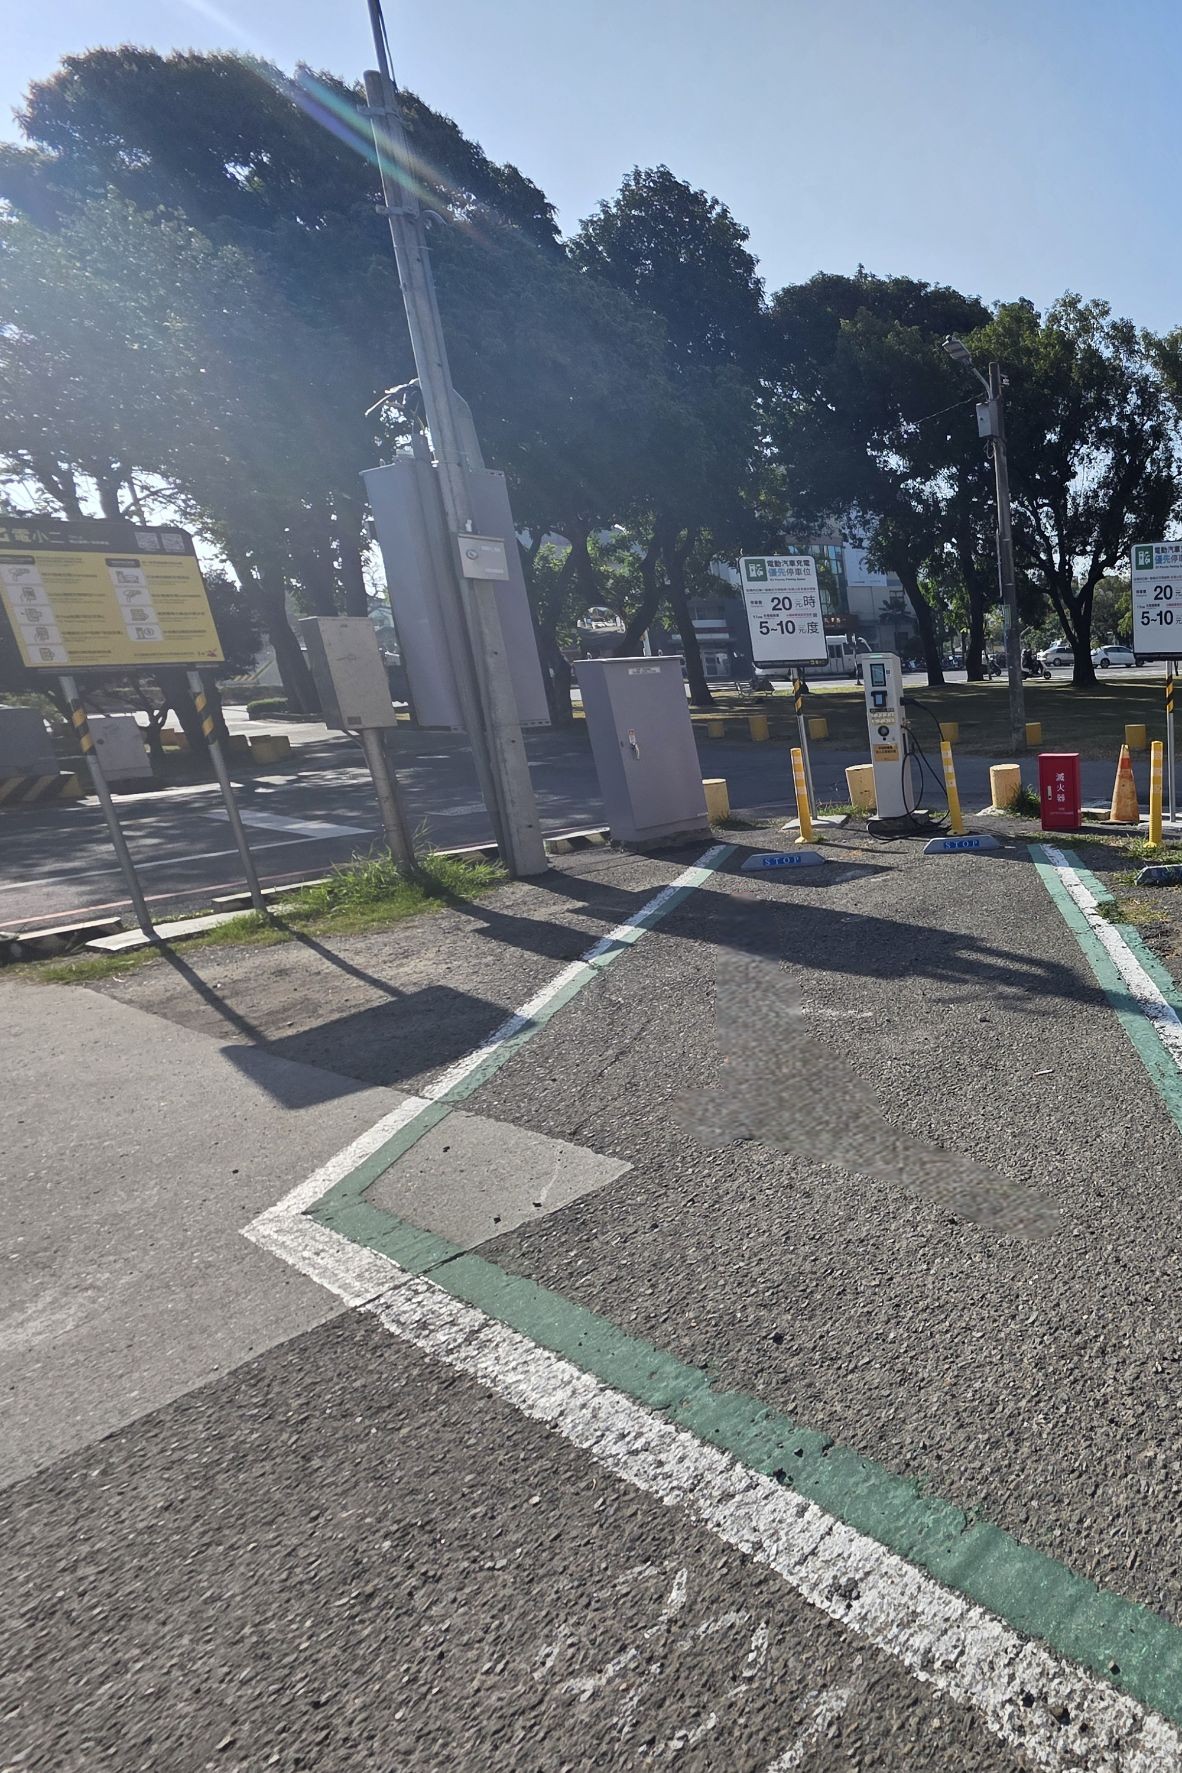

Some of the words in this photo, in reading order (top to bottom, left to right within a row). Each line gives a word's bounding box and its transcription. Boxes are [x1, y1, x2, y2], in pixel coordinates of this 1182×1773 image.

[767, 559, 811, 568] 電動汽車充電
[768, 568, 811, 577] 優先停車位
[1153, 585, 1173, 601] 20
[771, 596, 793, 611] 20
[1141, 610, 1173, 626] 5~10
[759, 620, 796, 636] 5~10
[1055, 772, 1066, 803] 滅火器
[944, 840, 979, 849] STOP
[764, 856, 800, 865] STOP
